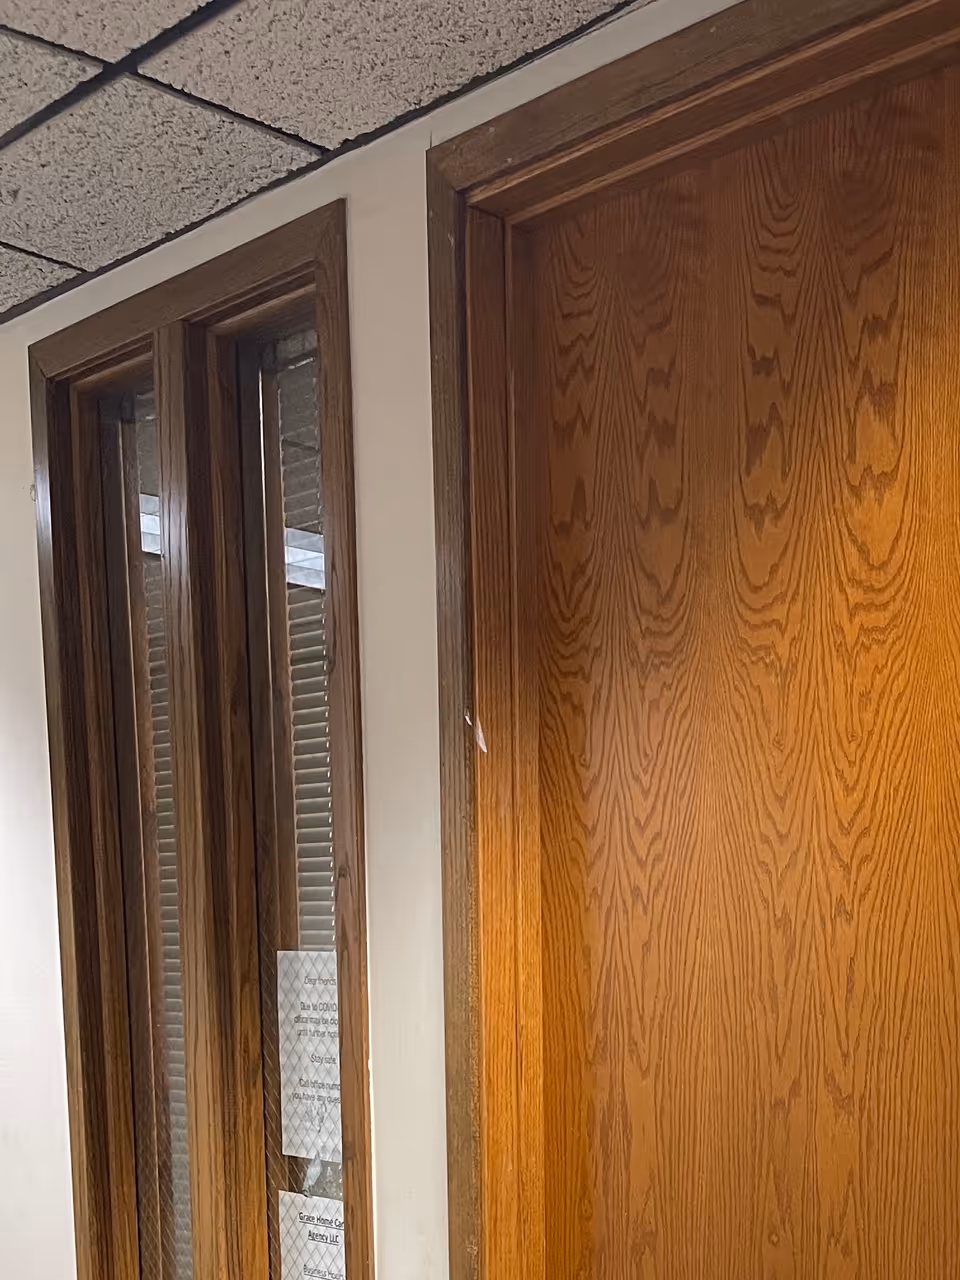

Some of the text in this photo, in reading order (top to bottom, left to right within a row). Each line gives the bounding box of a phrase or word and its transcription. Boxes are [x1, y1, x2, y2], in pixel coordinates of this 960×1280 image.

[298, 1212, 315, 1223] Grace
[316, 1215, 333, 1226] Home
[308, 1230, 339, 1243] Agency LLC
